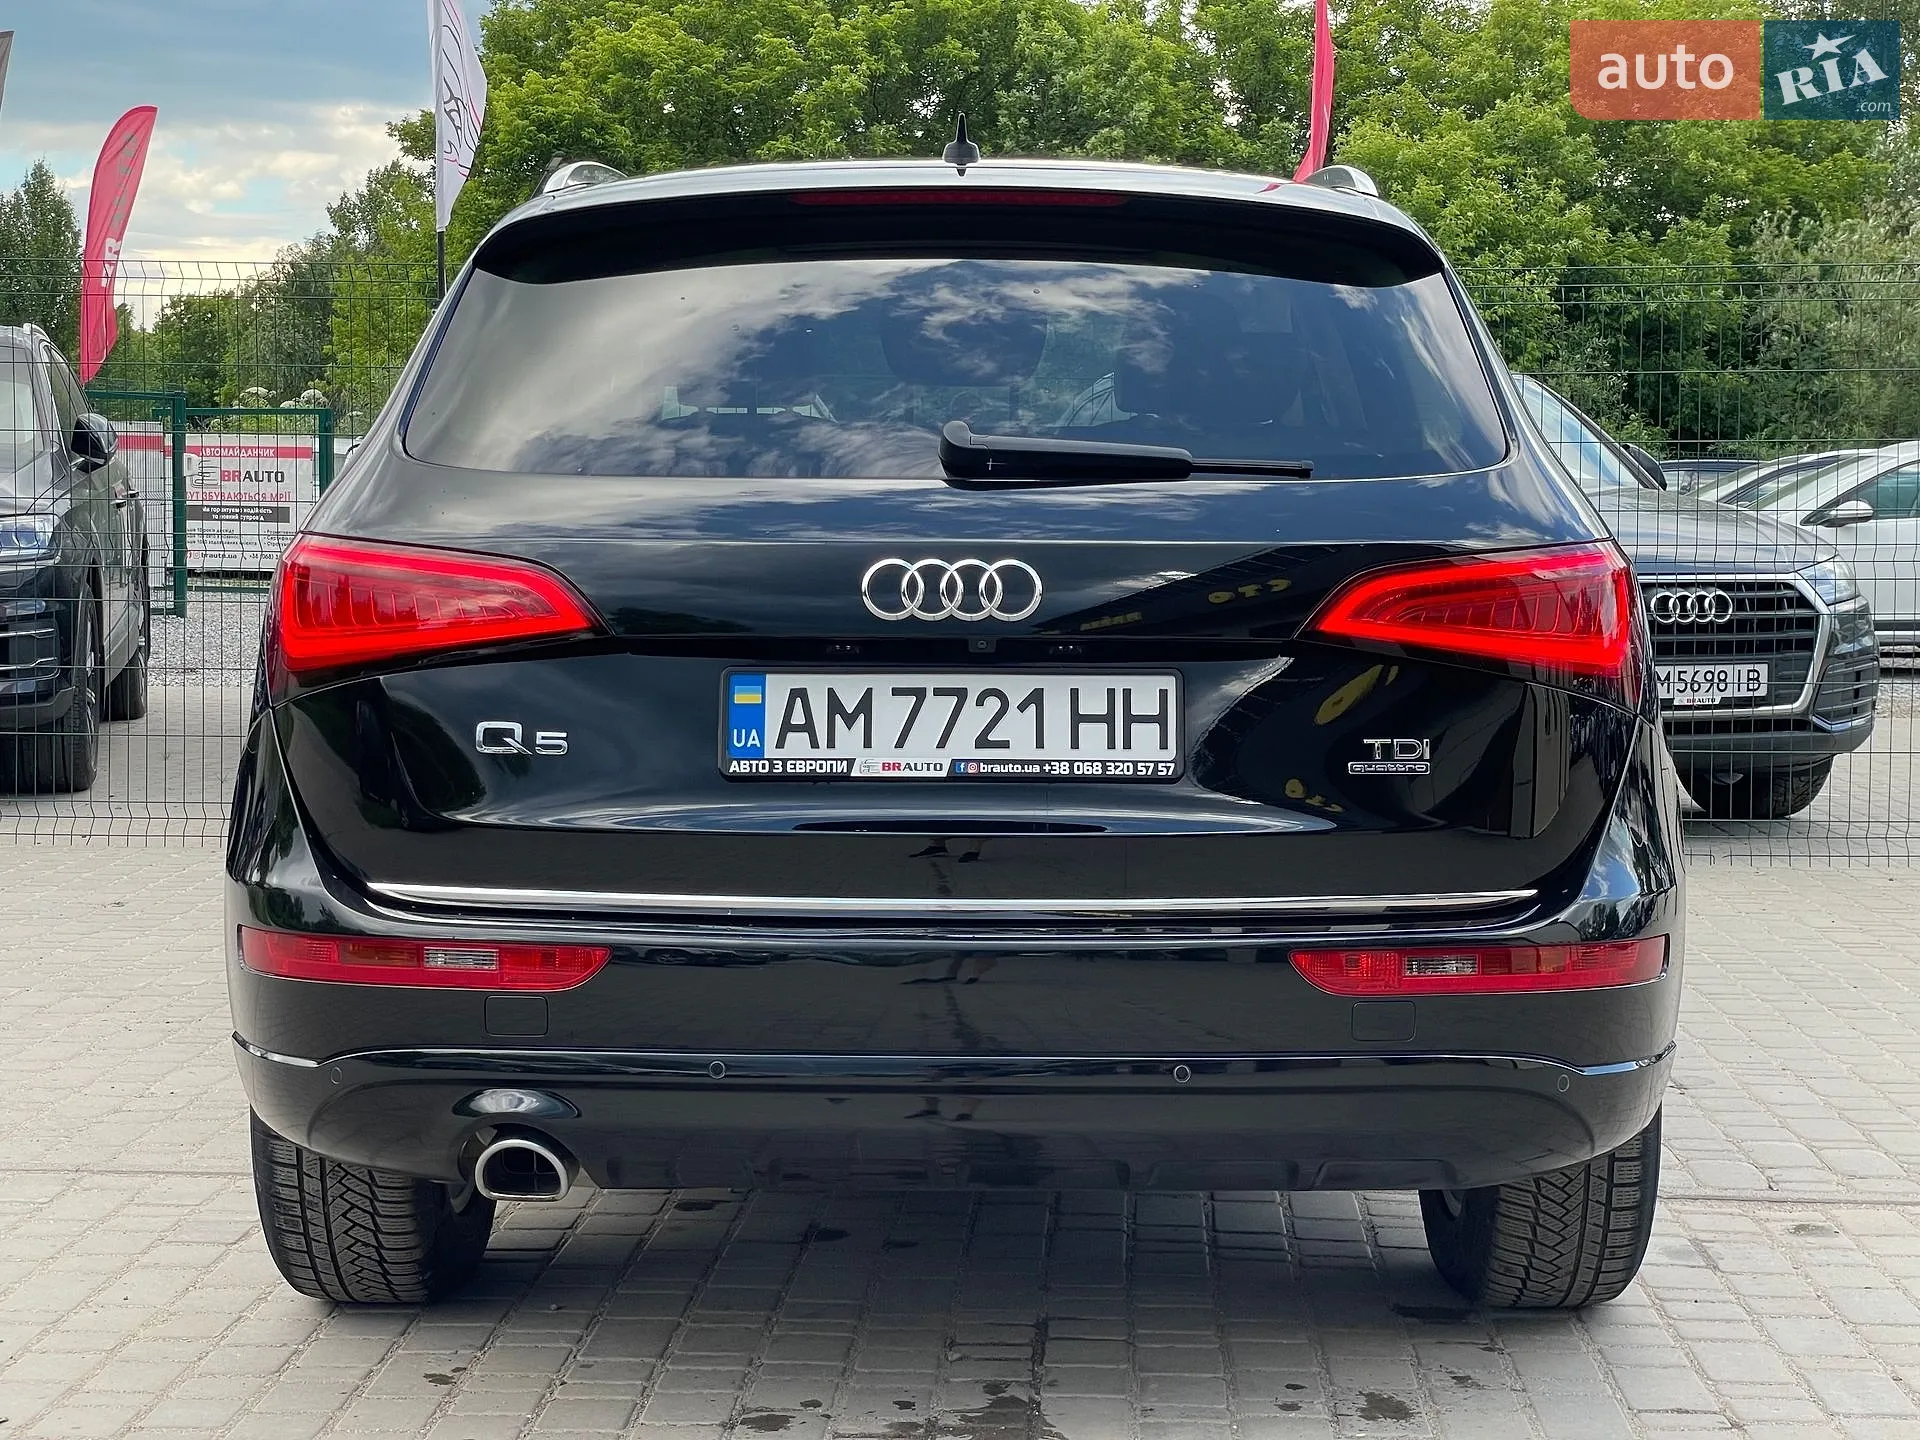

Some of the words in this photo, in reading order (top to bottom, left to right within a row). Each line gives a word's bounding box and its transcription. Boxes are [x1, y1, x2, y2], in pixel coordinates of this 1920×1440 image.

[200, 446, 275, 458] АВТОМАЙДАНЧИК
[221, 469, 285, 483] BRAUTO
[1676, 669, 1728, 693] 5698
[775, 687, 873, 749] AM
[891, 687, 1045, 749] 7721
[1069, 687, 1169, 750] HH
[733, 728, 761, 747] UA
[1363, 738, 1430, 760] TDI
[728, 760, 770, 773] АВТО
[786, 760, 848, 773] ЄВРОПИ
[881, 761, 944, 772] BRAUTO
[979, 762, 1040, 773] brauto.ua
[1043, 761, 1070, 775] +38
[1073, 762, 1102, 775] 068
[1106, 762, 1134, 775] 320
[1137, 763, 1155, 776] 57
[1157, 763, 1176, 776] 57
[1351, 764, 1427, 773] quattro
